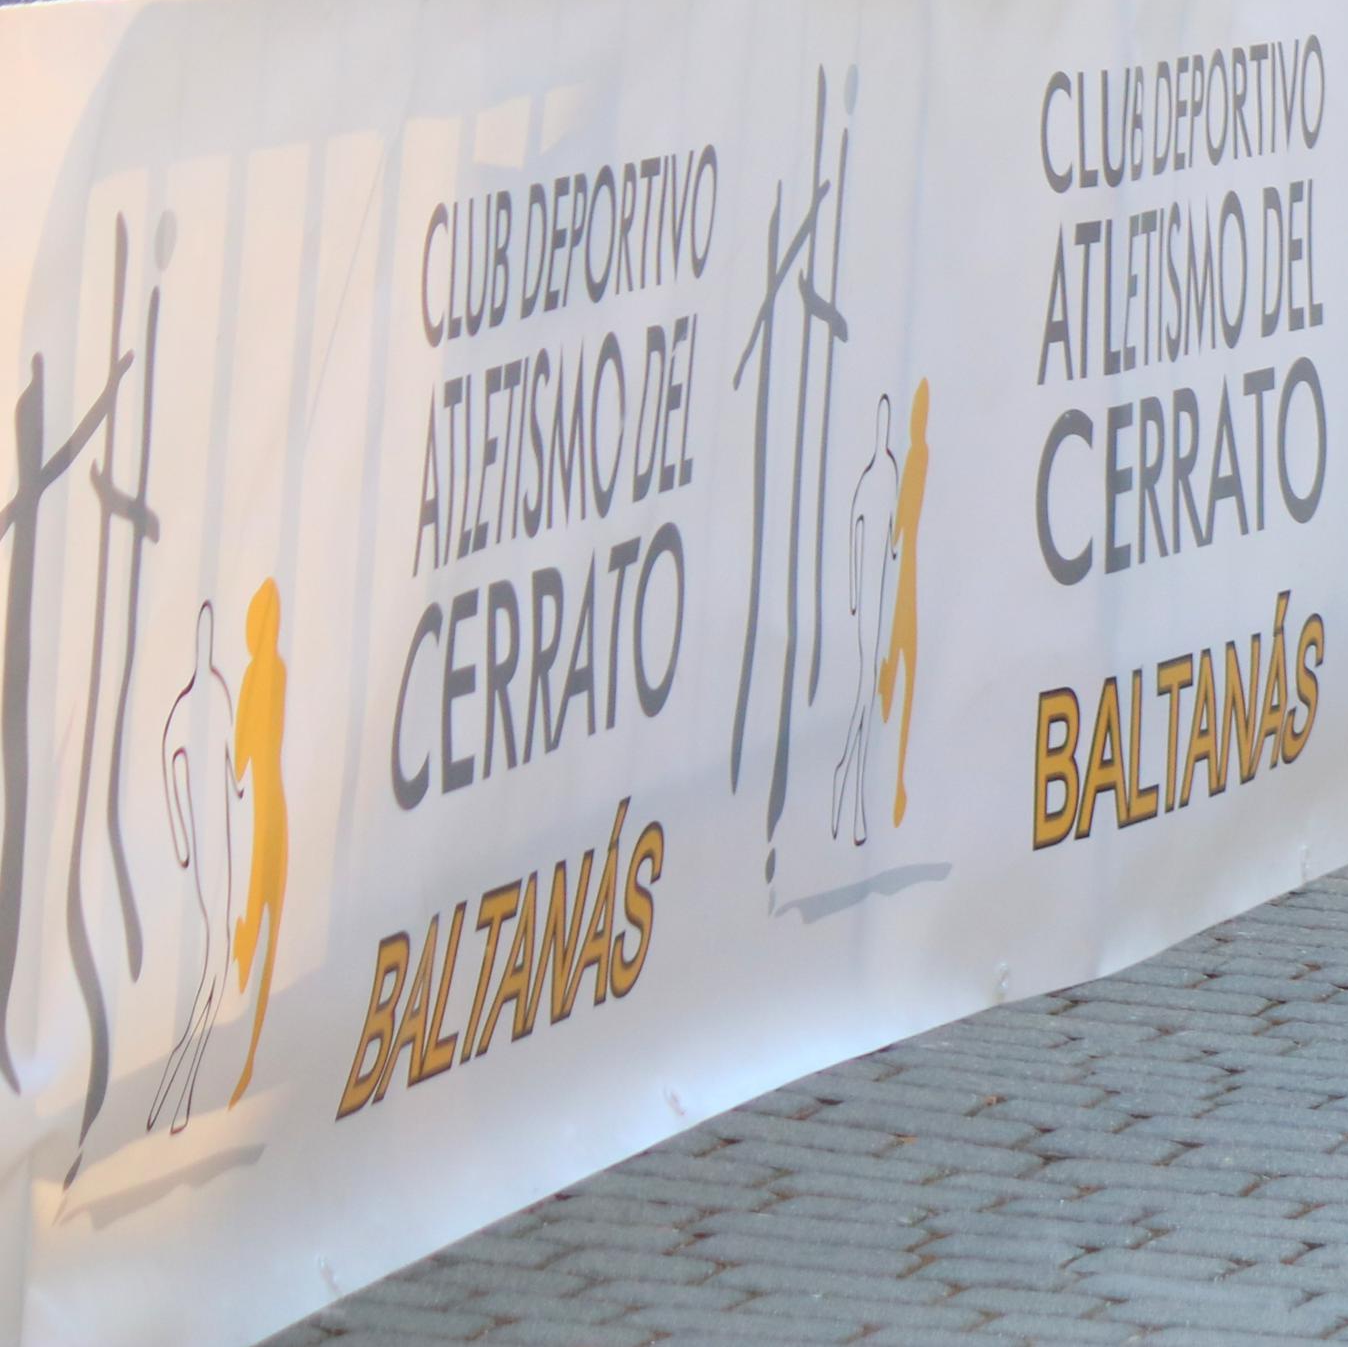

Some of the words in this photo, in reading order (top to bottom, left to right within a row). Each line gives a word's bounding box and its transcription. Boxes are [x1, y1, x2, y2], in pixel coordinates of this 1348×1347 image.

[1040, 64, 1146, 195] CLUB
[1152, 34, 1326, 178] DEPORTIVO
[421, 189, 515, 349] CLUB
[519, 143, 718, 321] DEPORTIVO
[1036, 192, 1248, 387] ATLETISMO
[1261, 179, 1325, 338] DEL
[412, 330, 626, 578] ATLETISMO
[632, 313, 697, 503] DEL
[1034, 356, 1329, 588] CERRATO
[391, 522, 686, 812] CERRATO
[1032, 590, 1326, 853] BALTANÁS
[334, 796, 666, 1123] BALTANÁS
